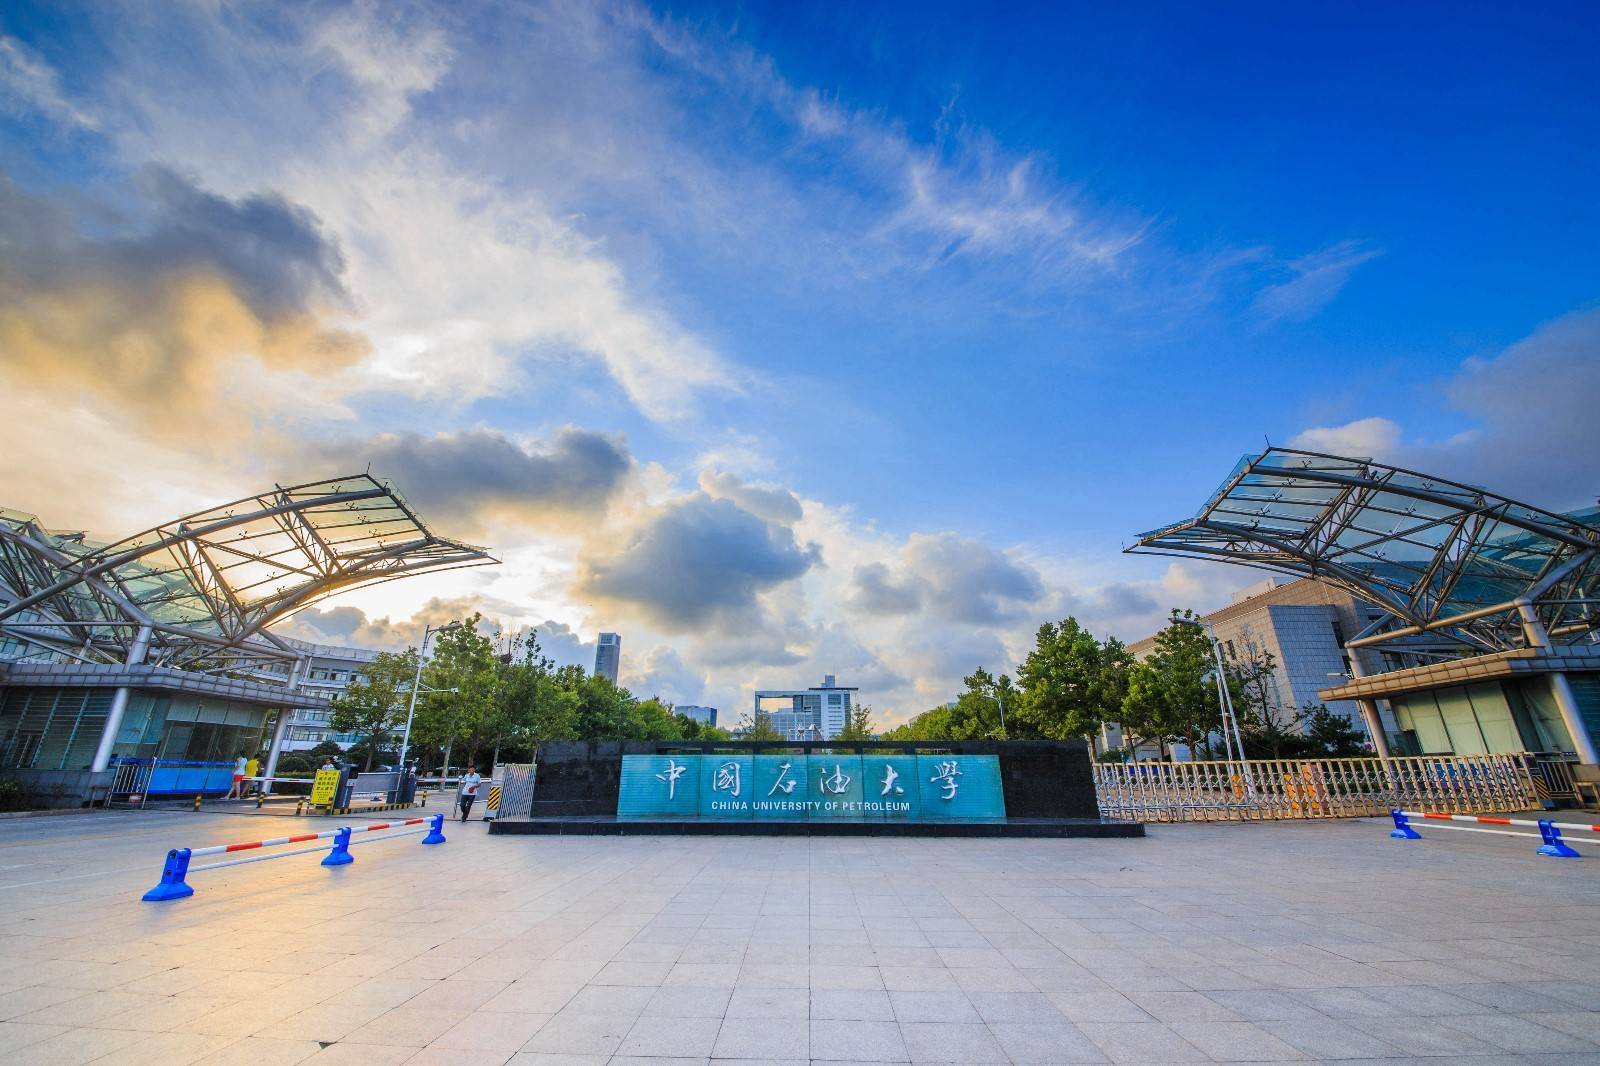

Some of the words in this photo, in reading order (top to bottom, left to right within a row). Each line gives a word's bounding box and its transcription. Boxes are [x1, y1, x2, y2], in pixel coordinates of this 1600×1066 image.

[711, 801, 748, 810] CHINA
[752, 801, 821, 811] UNIVERSITY
[824, 801, 838, 811] OF
[842, 801, 910, 811] PETROLEUM
